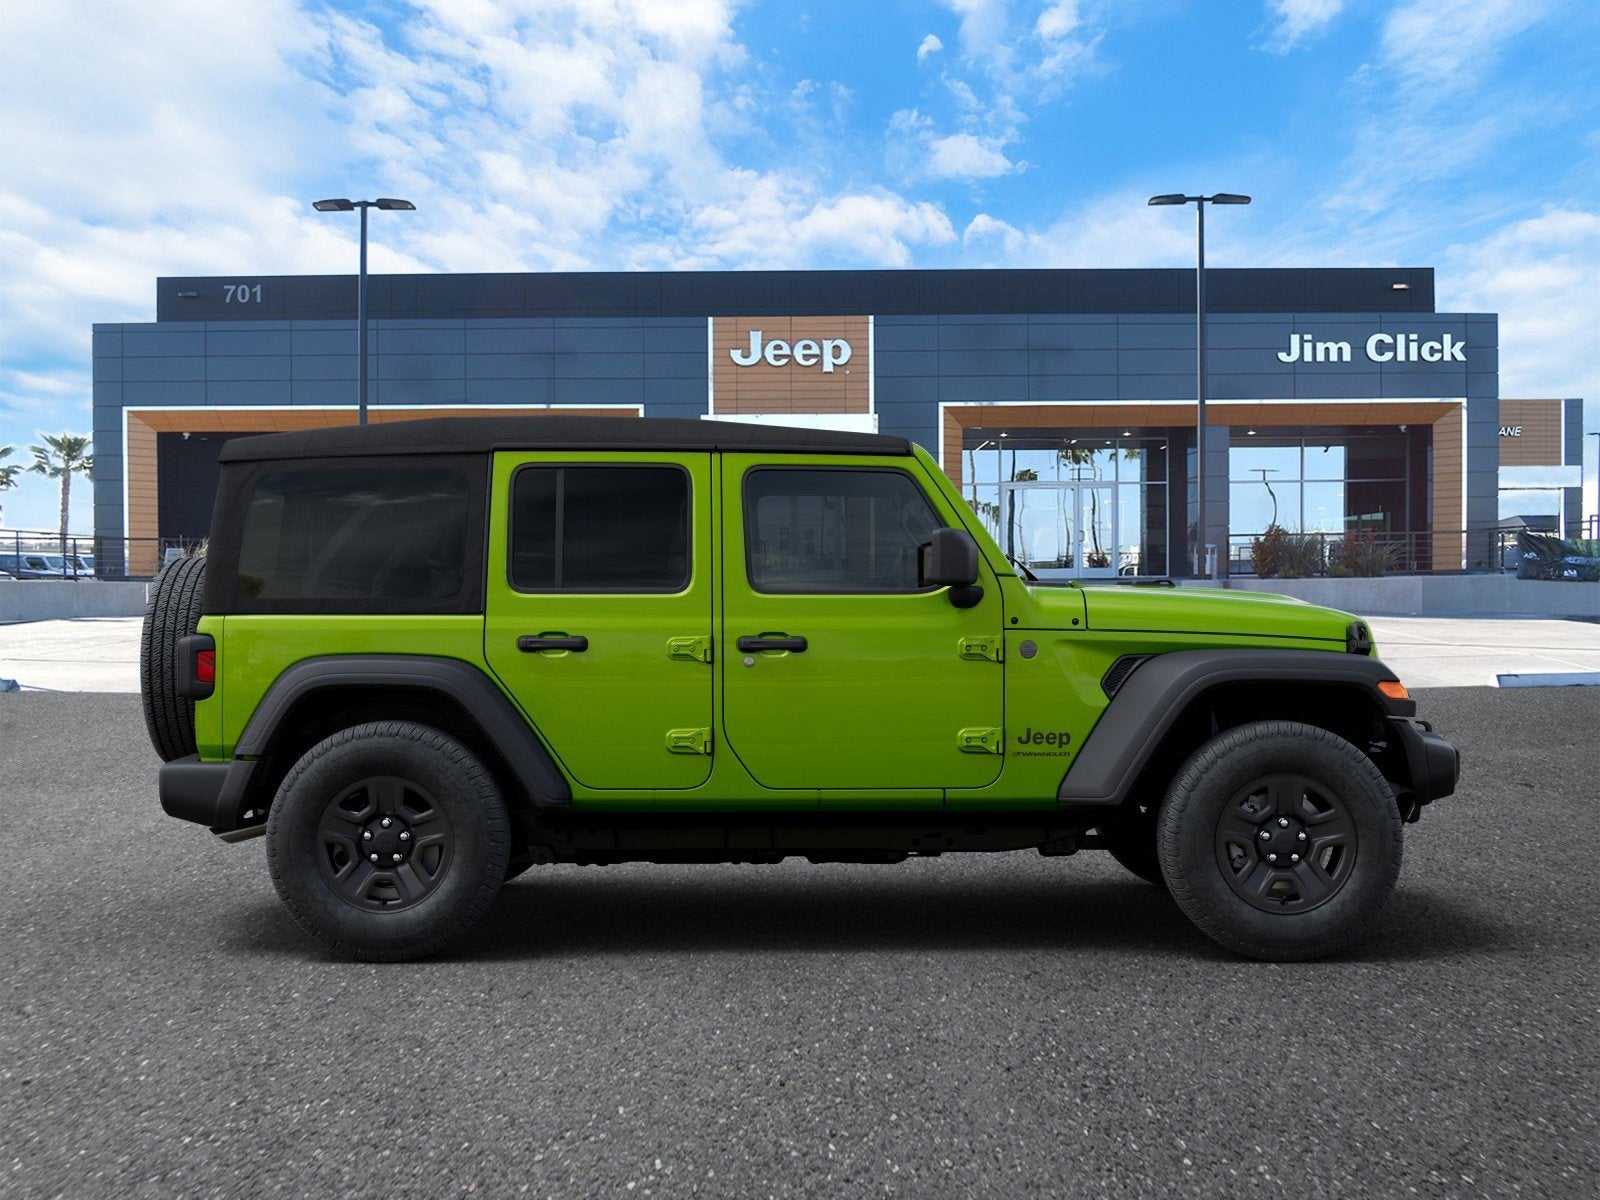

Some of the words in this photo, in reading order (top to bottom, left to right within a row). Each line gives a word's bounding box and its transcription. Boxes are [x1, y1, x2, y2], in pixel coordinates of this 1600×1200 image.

[223, 284, 262, 304] 701
[729, 330, 852, 373] Jeep
[1277, 333, 1351, 363] Jim
[1366, 333, 1467, 362] Click
[1017, 727, 1071, 749] Jeep
